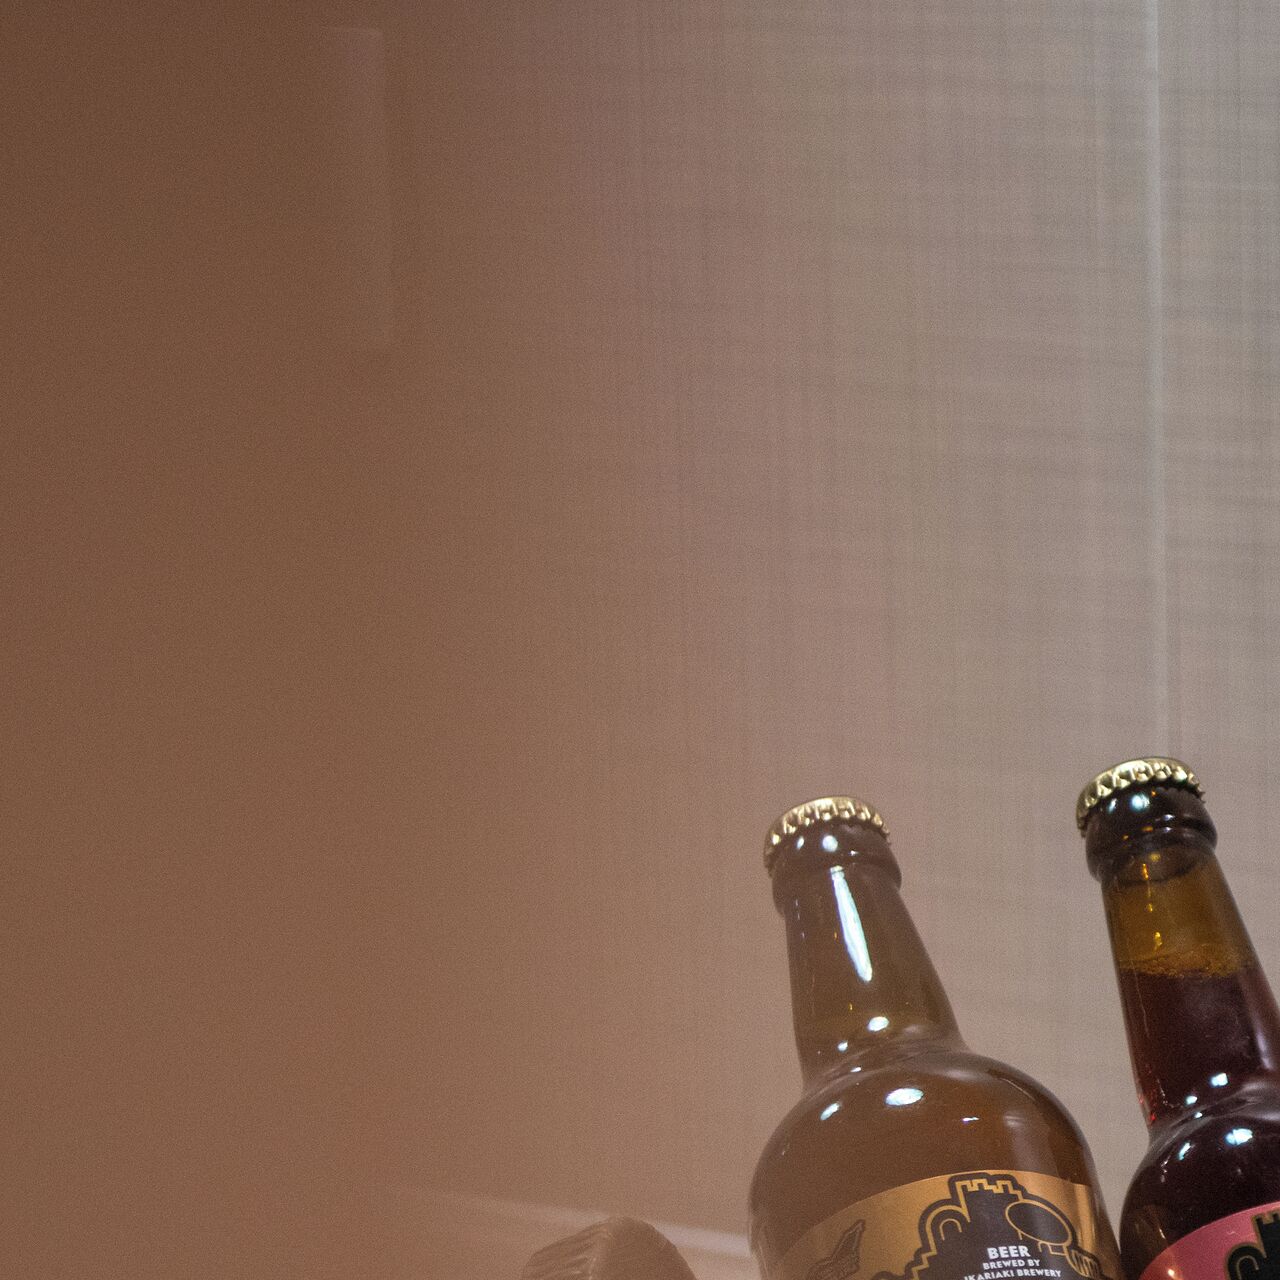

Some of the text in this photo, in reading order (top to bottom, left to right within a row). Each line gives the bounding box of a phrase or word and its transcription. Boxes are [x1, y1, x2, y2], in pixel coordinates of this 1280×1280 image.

[986, 1245, 1031, 1259] BEER
[982, 1259, 1040, 1270] BREWED BY
[1016, 1269, 1061, 1278] BREWERY
